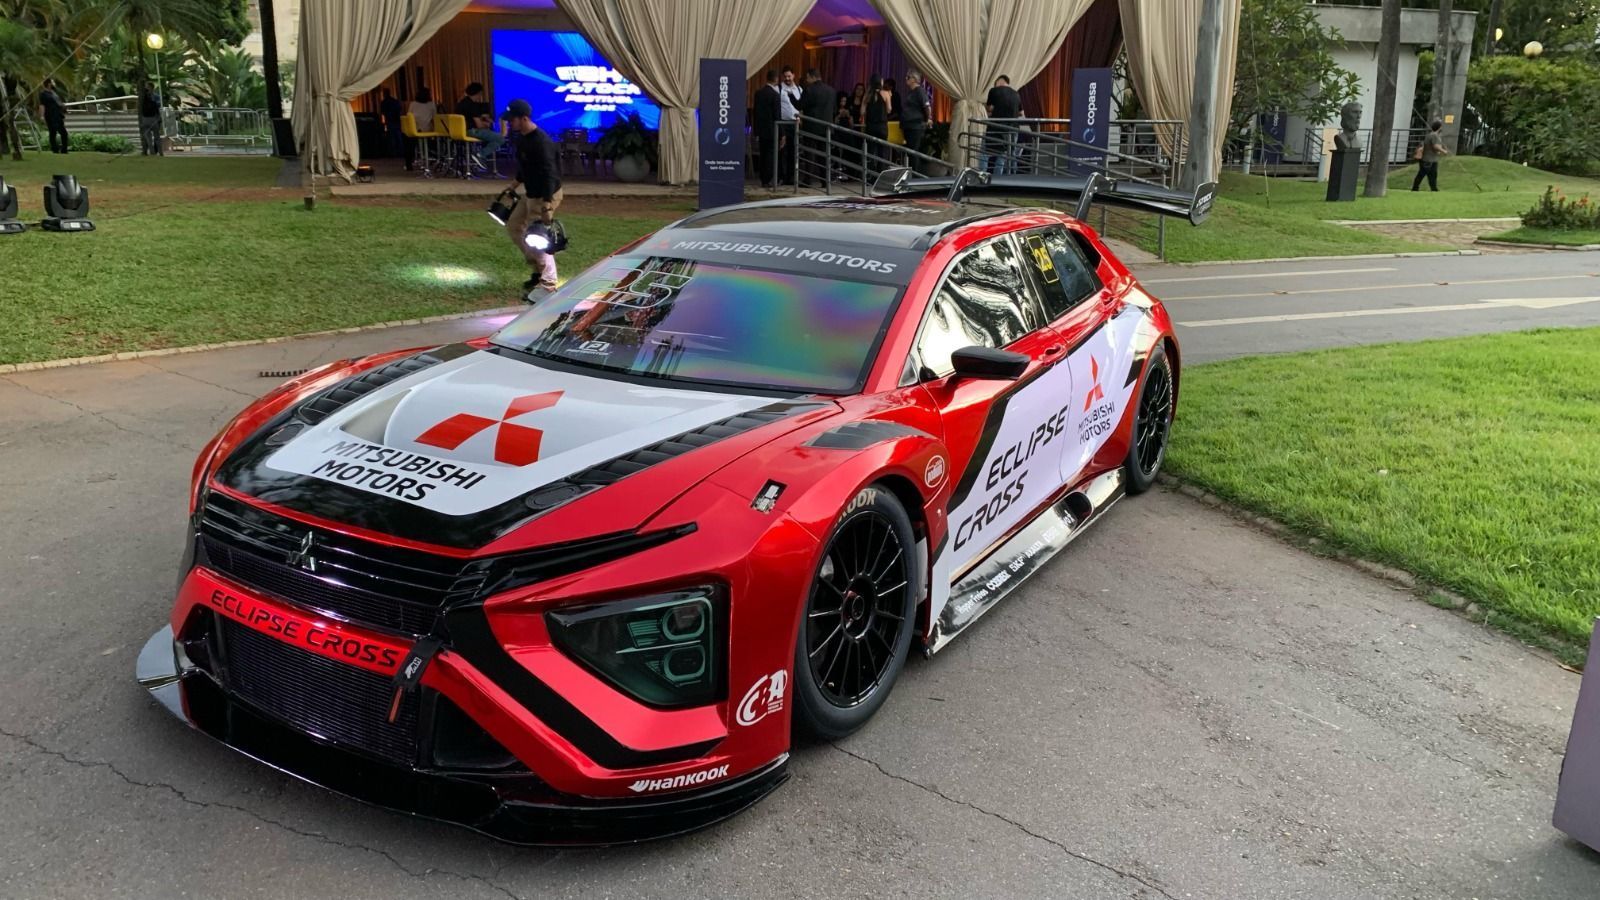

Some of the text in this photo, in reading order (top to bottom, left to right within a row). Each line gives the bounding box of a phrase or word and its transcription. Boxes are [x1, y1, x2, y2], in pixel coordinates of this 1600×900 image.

[719, 76, 730, 125] copasa
[1087, 82, 1097, 126] copasa
[672, 240, 897, 274] MITSUBISHI MOTORS
[1034, 247, 1053, 271] 25
[1078, 401, 1115, 433] MITSUBISHI
[1080, 418, 1111, 445] MOTORS
[322, 441, 487, 489] MITSUBISHI
[985, 405, 1068, 492] ECLIPSE
[311, 460, 437, 500] MOTORS
[953, 469, 1028, 552] CROSS
[1009, 556, 1025, 572] SKF
[211, 589, 301, 638] ECLIPSE
[306, 628, 400, 668] CROSS
